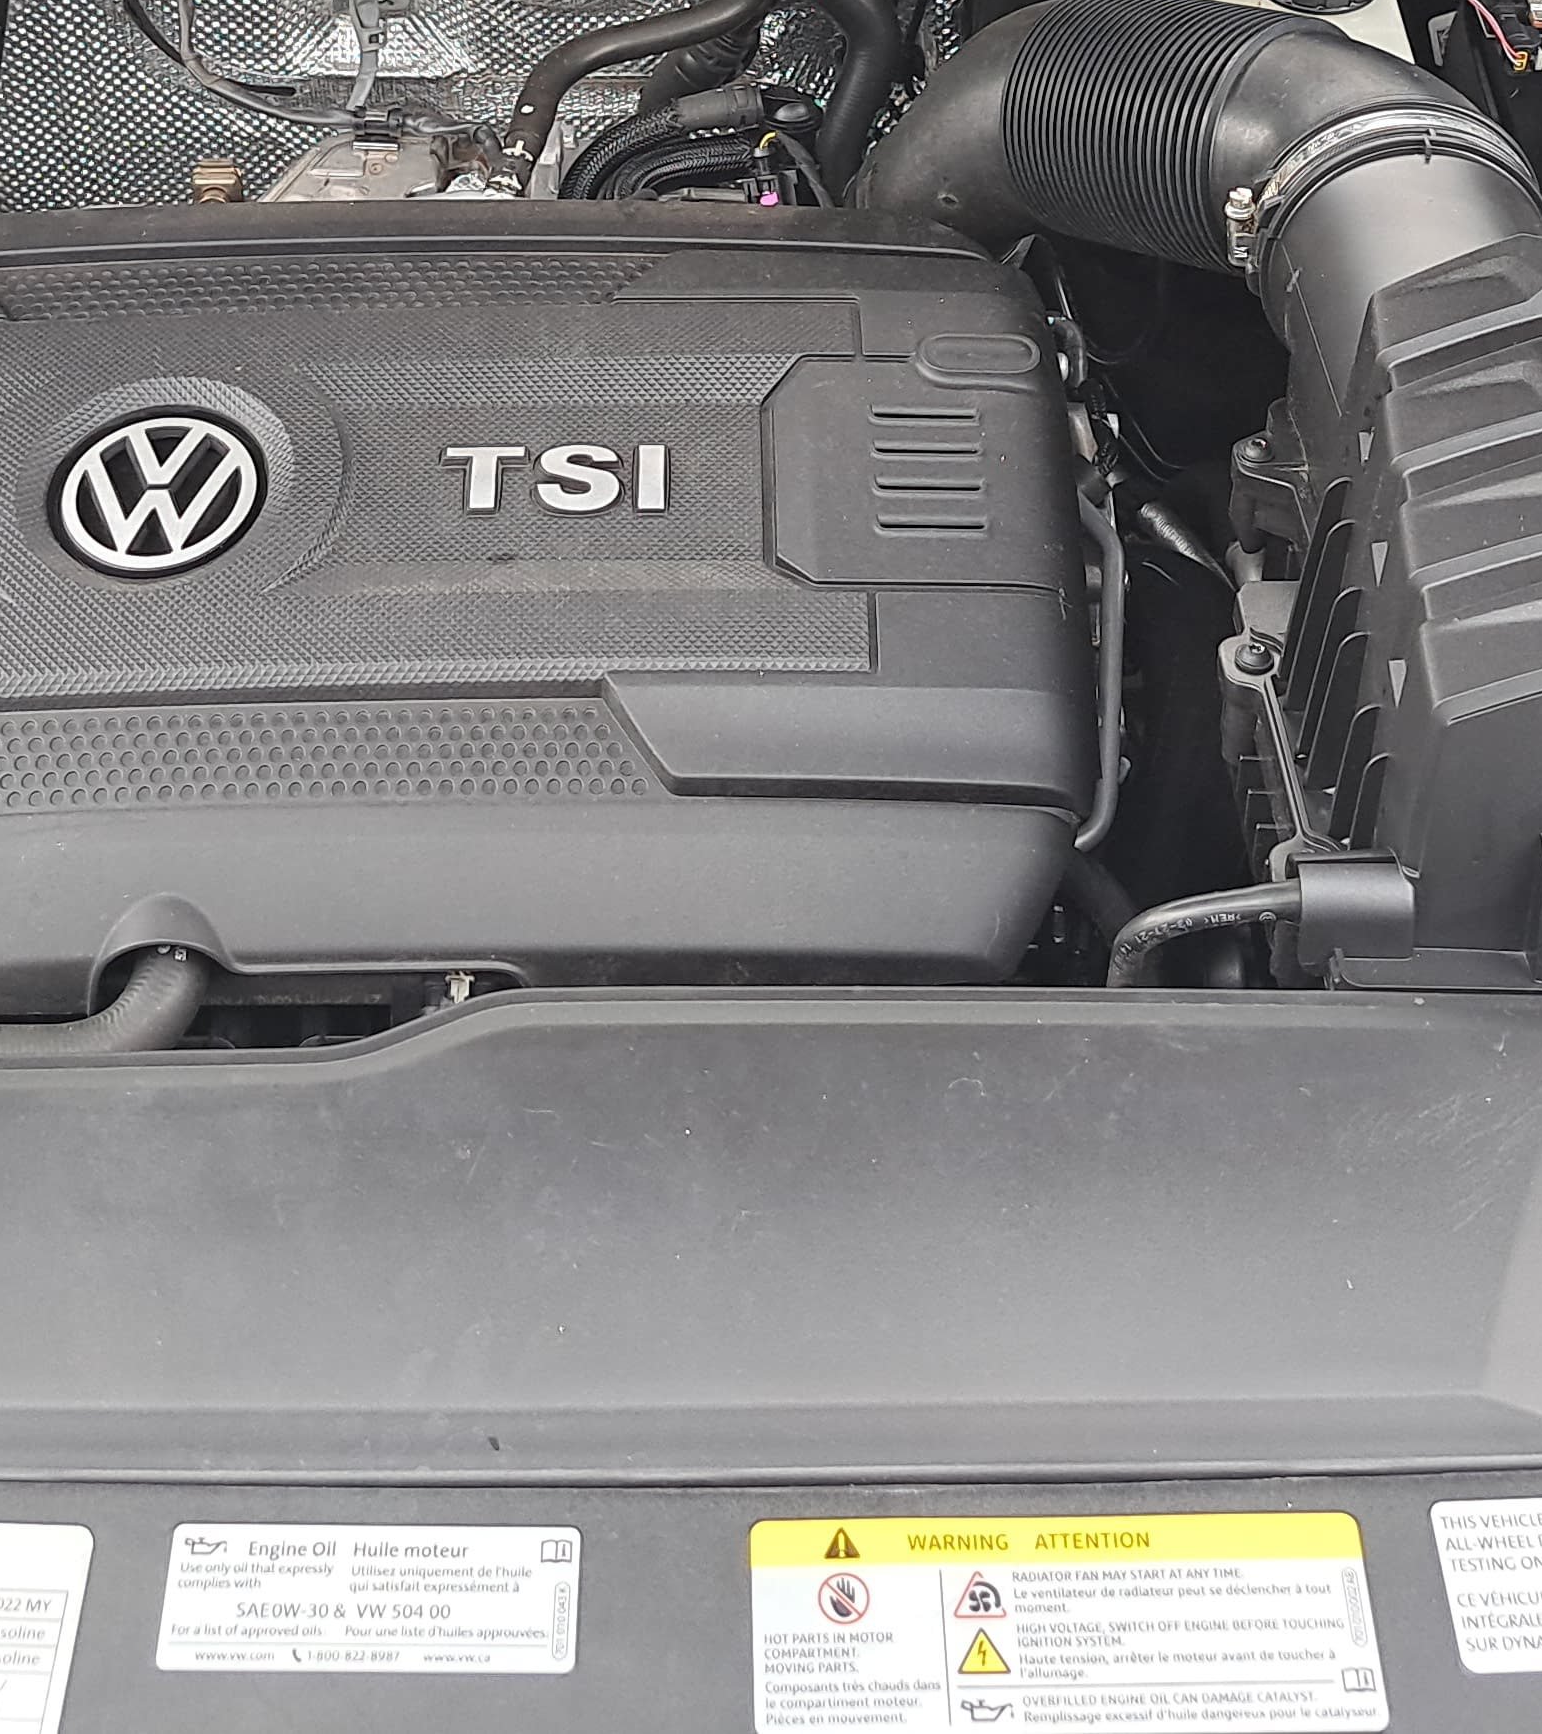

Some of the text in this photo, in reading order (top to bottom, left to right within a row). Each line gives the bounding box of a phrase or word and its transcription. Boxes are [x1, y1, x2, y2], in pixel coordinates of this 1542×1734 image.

[445, 444, 669, 513] TSI
[1439, 1515, 1477, 1530] THIS
[907, 1533, 1010, 1554] WARNING
[1035, 1531, 1150, 1552] ATTENTION
[1445, 1534, 1535, 1552] ALL-WHEEL
[248, 1540, 337, 1561] Engine Oil
[353, 1541, 469, 1559] Huile moteur
[180, 1561, 334, 1578] Use only oil that expressly
[1451, 1556, 1517, 1572] TESTING
[351, 1565, 532, 1580] Utilisez uniquement de l'huile
[1011, 1567, 1210, 1583] RADIATOR FAN MAY START AT ANY
[177, 1576, 262, 1591] complies with
[349, 1579, 509, 1594] qui satisfait expressément
[1013, 1583, 1332, 1600] Le ventilateur de radiateur peut se déclencher tout
[25, 1598, 52, 1613] MY
[1456, 1593, 1476, 1608] CE
[333, 1602, 451, 1620] & VW 504 00
[171, 1623, 299, 1639] For list of approved
[344, 1625, 372, 1638] Pour
[375, 1628, 399, 1638] une
[400, 1625, 426, 1638] liste
[1016, 1622, 1047, 1635] HIGH
[1108, 1620, 1155, 1634] SWITCH
[1157, 1620, 1181, 1633] OFF
[1184, 1619, 1229, 1632] ENGINE
[1232, 1618, 1279, 1632] BEFORE
[1282, 1618, 1345, 1630] TOUCHING
[763, 1631, 894, 1646] HOT PARTS IN MOTOR
[1017, 1635, 1073, 1649] IGNITION
[1465, 1636, 1499, 1652] SUR
[195, 1651, 275, 1662] www.vw.com
[1018, 1649, 1324, 1666] Haute tension, le moteur avant de toucher
[764, 1661, 815, 1675] MOVING
[764, 1678, 942, 1696] Composants chauds dans
[765, 1696, 870, 1711] le compartiment
[1100, 1691, 1253, 1706] ENGINE OIL CAN DAMAGE
[808, 1714, 825, 1726] en
[1023, 1710, 1102, 1725] Remplissage
[1105, 1708, 1153, 1723] excessif
[1156, 1708, 1198, 1721] d'huile
[1269, 1708, 1296, 1721] pour
[1299, 1706, 1312, 1719] le
